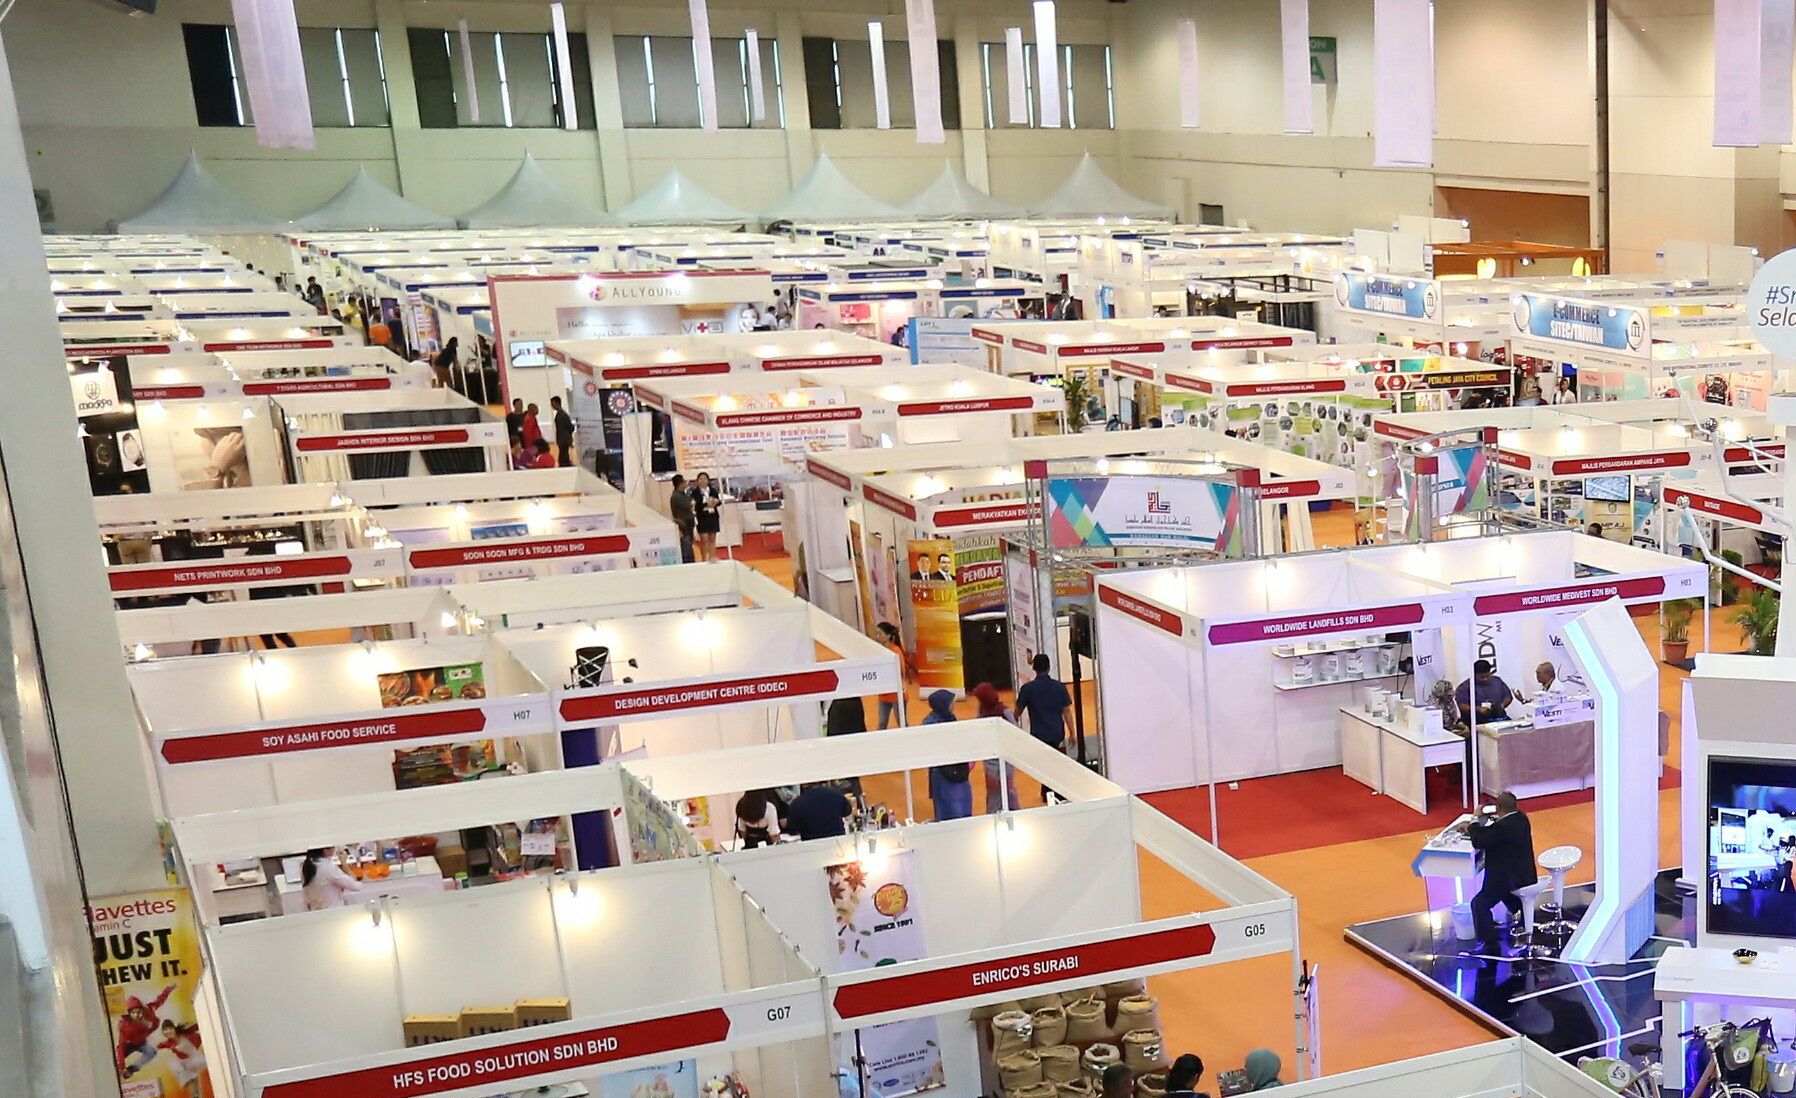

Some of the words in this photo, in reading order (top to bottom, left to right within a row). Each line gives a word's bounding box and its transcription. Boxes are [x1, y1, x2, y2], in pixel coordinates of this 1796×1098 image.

[174, 572, 196, 582] NETS
[197, 569, 246, 580] PRINTWORK
[247, 567, 264, 576] SDN
[265, 565, 283, 575] BHD
[1521, 594, 1560, 606] WORLDWIDE
[1561, 591, 1590, 603] MEDIVEST
[1591, 589, 1604, 599] SDN
[1604, 587, 1618, 598] BHD
[1263, 619, 1307, 635] WORLDWIDE
[1308, 616, 1344, 630] LANDFILLS
[1345, 615, 1359, 626] SDN
[1359, 613, 1374, 624] BHD
[861, 671, 878, 682] H05
[614, 696, 650, 710] DESIGN
[650, 688, 722, 706] DEVELOPMENT
[723, 684, 756, 699] CENTRE
[757, 680, 788, 695] (DDEC)
[512, 709, 531, 721] H07
[262, 735, 285, 748] SOY
[286, 731, 318, 746] ASAHI
[320, 728, 351, 742] FOOD
[352, 723, 396, 739] SERVICE
[1244, 923, 1266, 938] G05
[972, 963, 1030, 987] ENRICO'S
[1032, 955, 1079, 976] SURABI
[766, 1005, 792, 1021] G07
[393, 1068, 425, 1090] HFS
[427, 1062, 472, 1084] FOOD
[475, 1049, 551, 1077] SOLUTION
[553, 1043, 584, 1063] SDN
[587, 1036, 619, 1055] BHD
